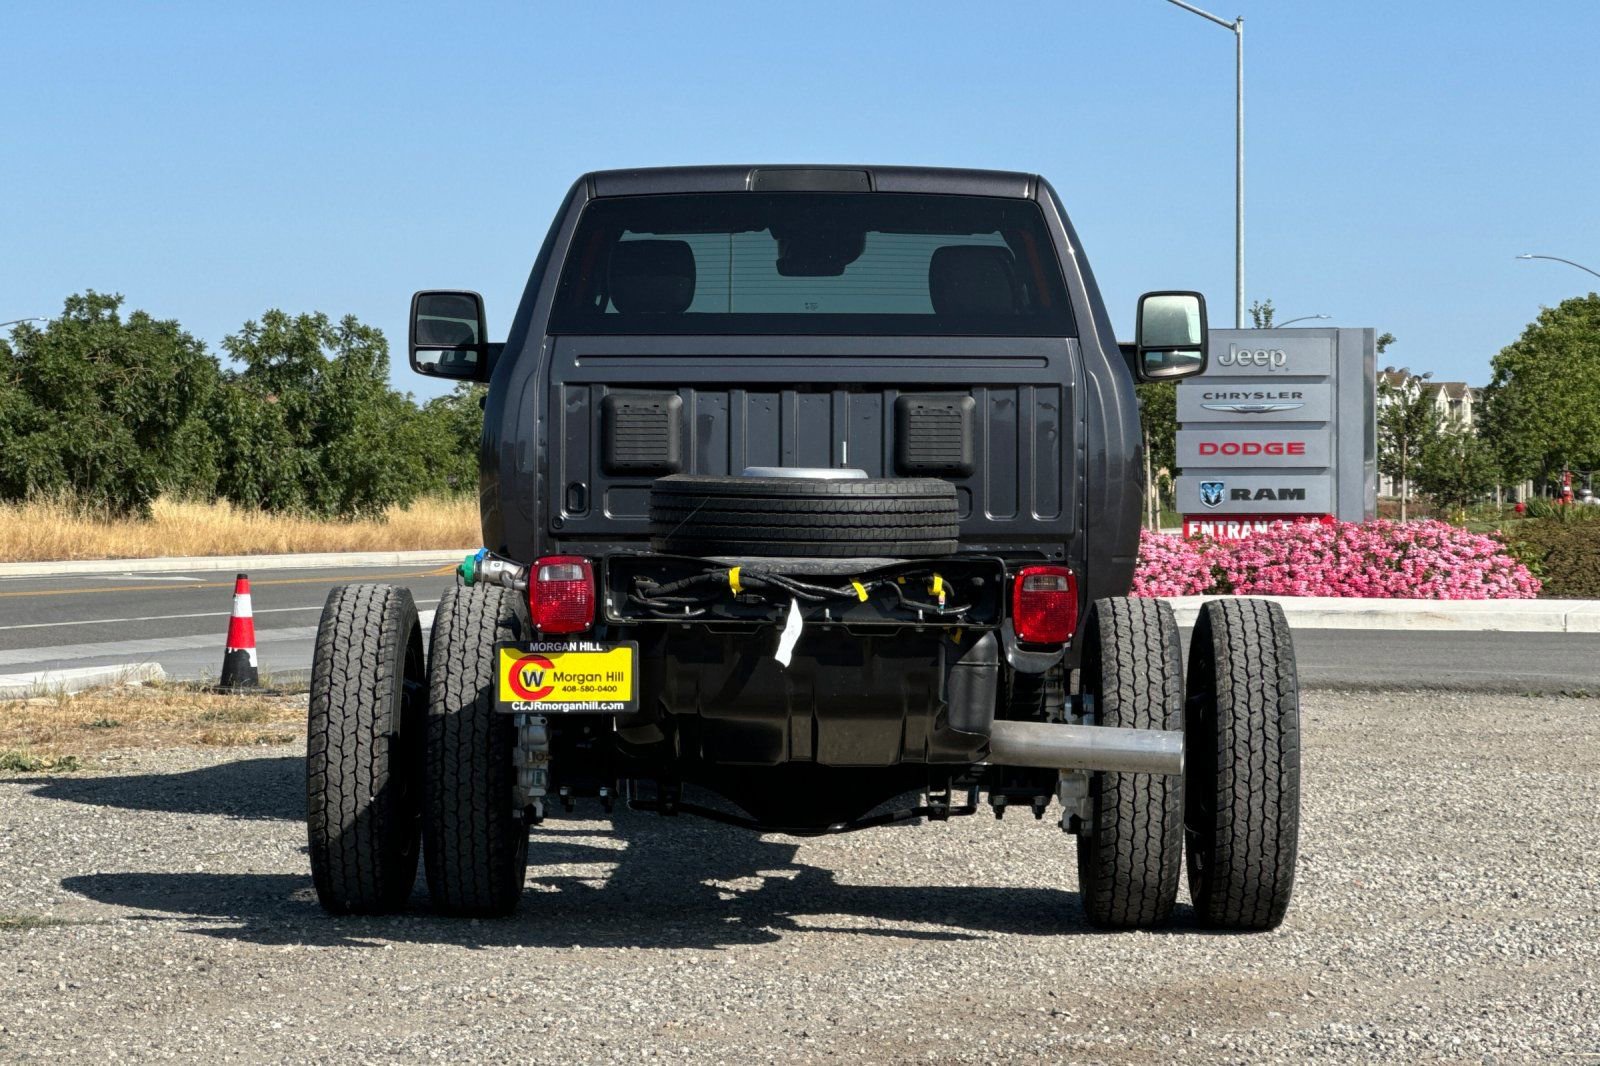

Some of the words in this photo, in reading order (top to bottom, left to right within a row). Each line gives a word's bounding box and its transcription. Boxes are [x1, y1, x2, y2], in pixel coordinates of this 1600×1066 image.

[1218, 343, 1287, 371] Jeep
[1202, 391, 1303, 400] CHRYSLER
[1199, 442, 1306, 456] DODGE
[1230, 488, 1306, 501] RAM
[1188, 520, 1294, 540] ENTRAN
[530, 642, 577, 652] MORGAN
[579, 642, 603, 651] HILL
[522, 670, 545, 688] W
[553, 672, 602, 684] Morgan
[606, 671, 624, 682] Hill
[562, 685, 618, 693] 408-580-0400
